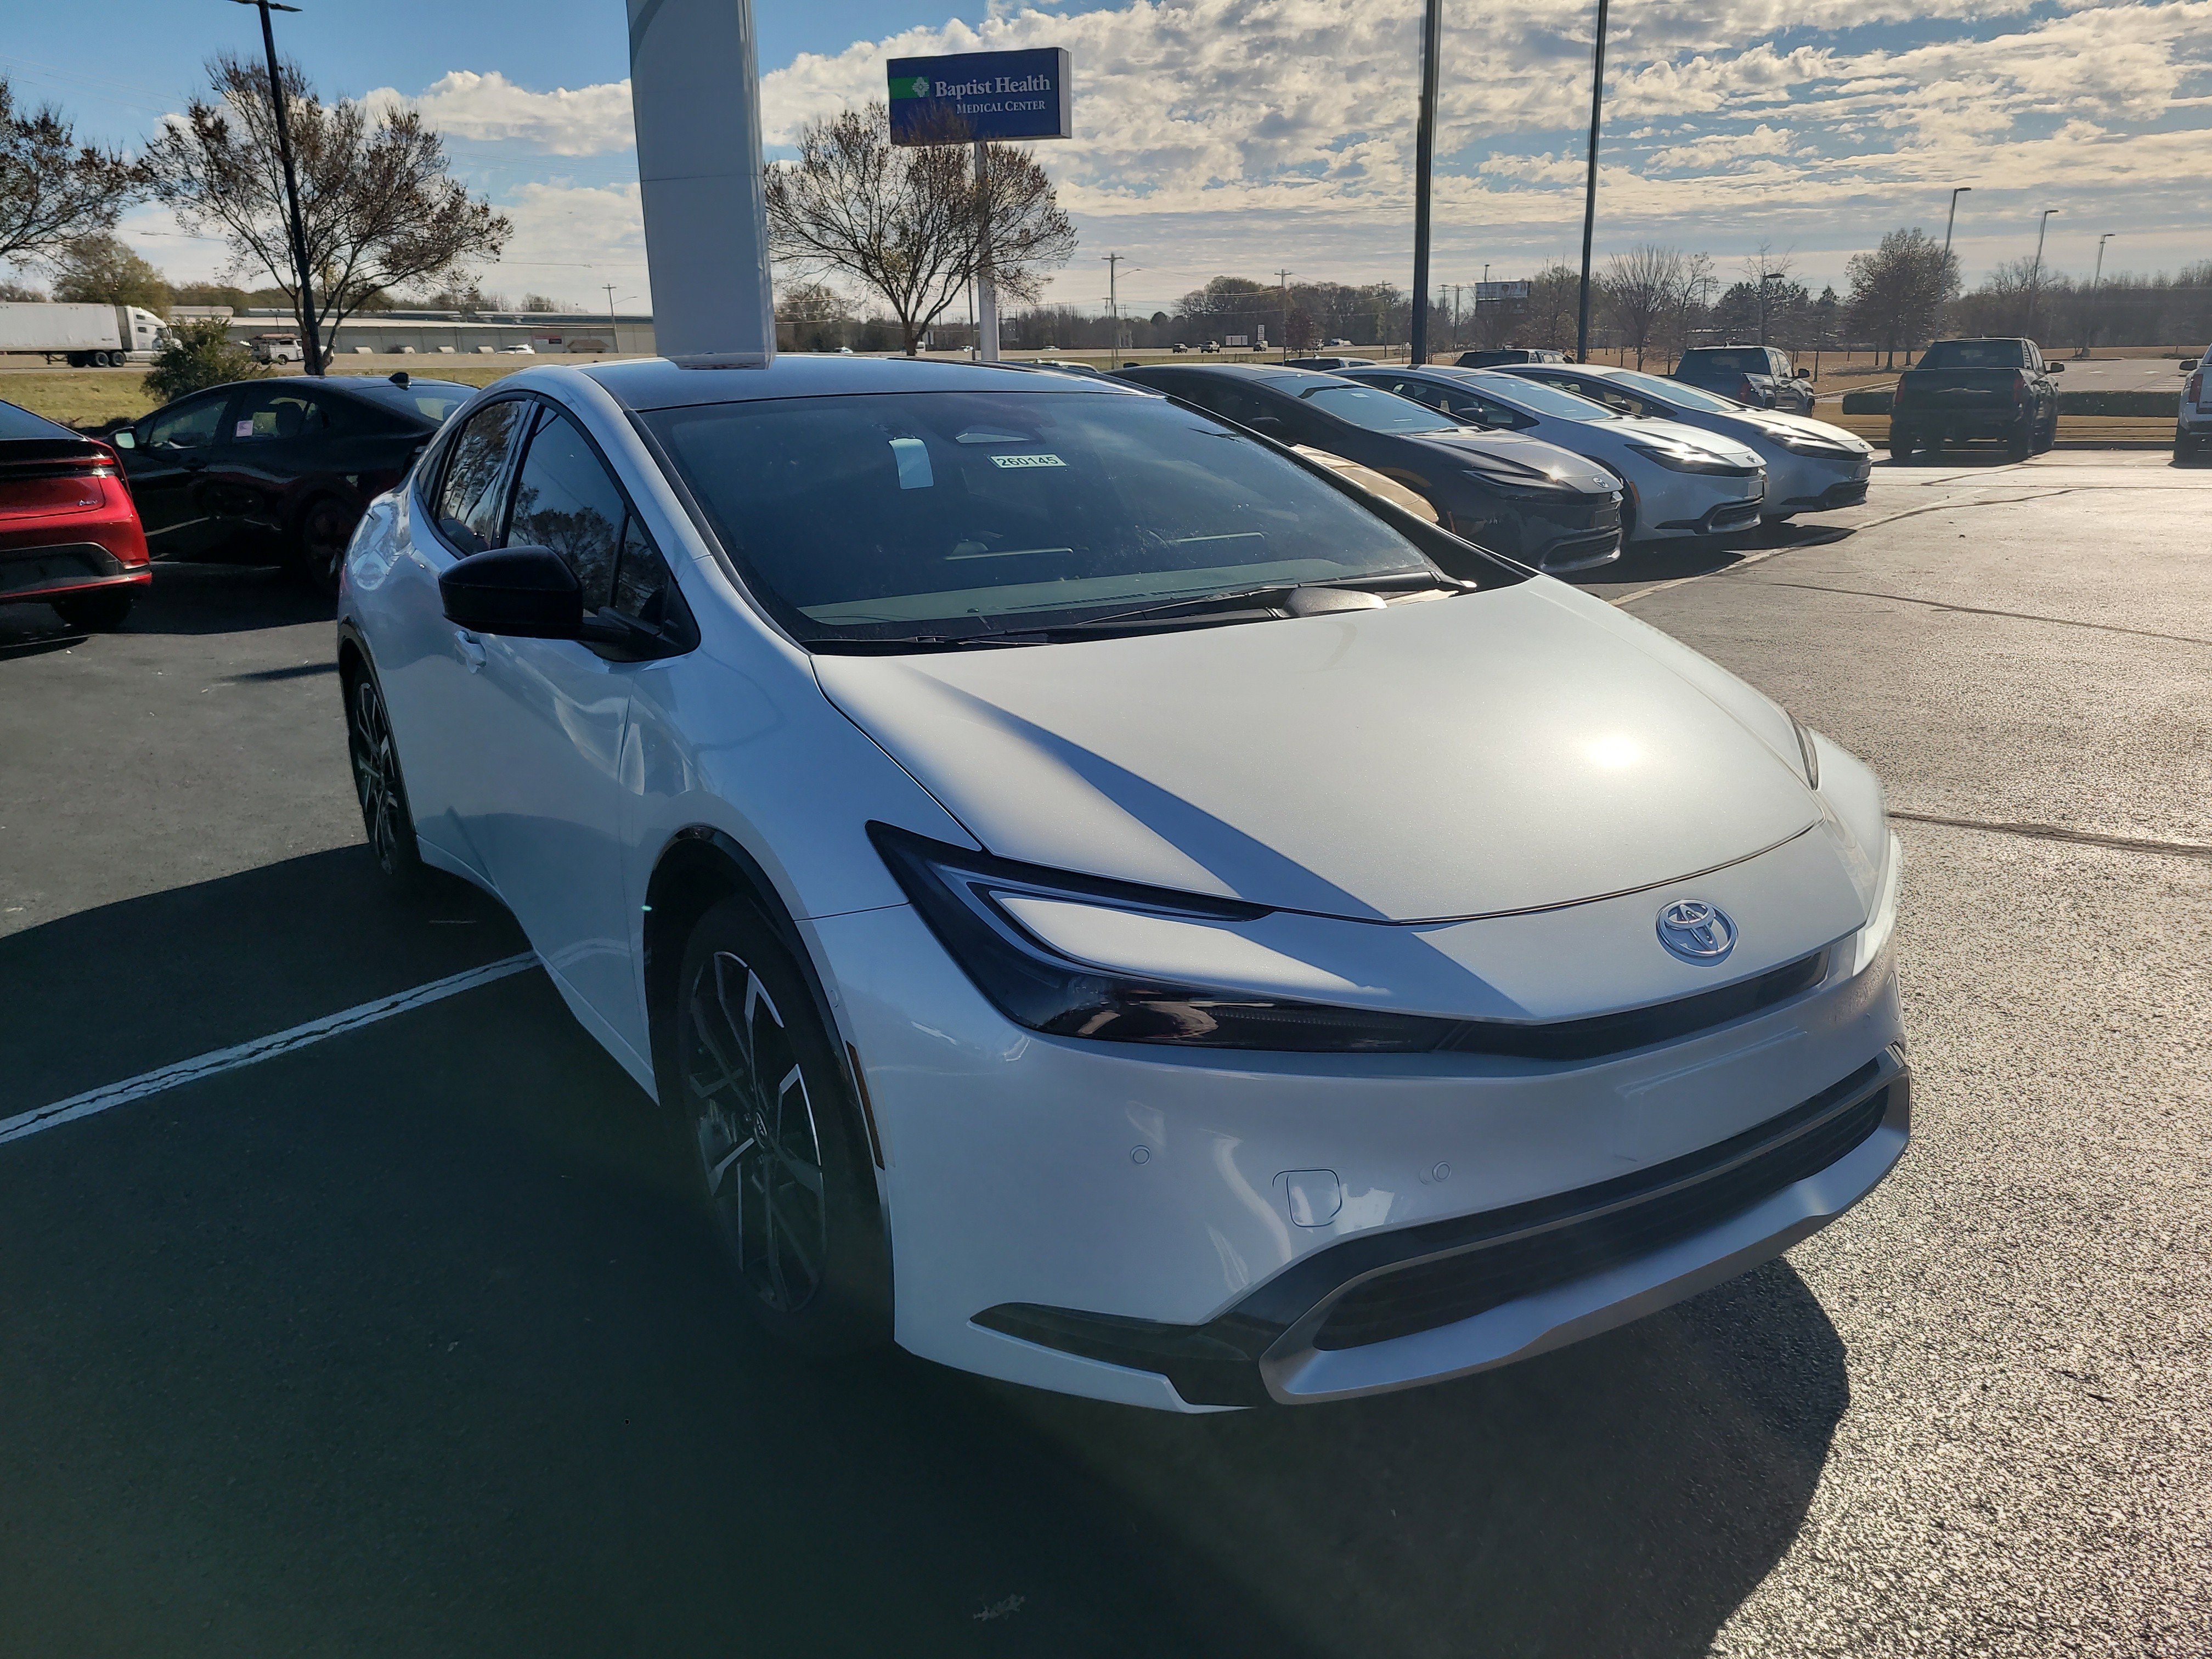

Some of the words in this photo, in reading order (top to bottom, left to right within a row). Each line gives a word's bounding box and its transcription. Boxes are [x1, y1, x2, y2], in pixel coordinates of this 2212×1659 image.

[935, 79, 992, 100] Baptist
[995, 74, 1051, 93] Health
[956, 103, 1003, 114] MEDICAL
[1005, 100, 1046, 111] CENTER
[997, 456, 1058, 466] 260145
